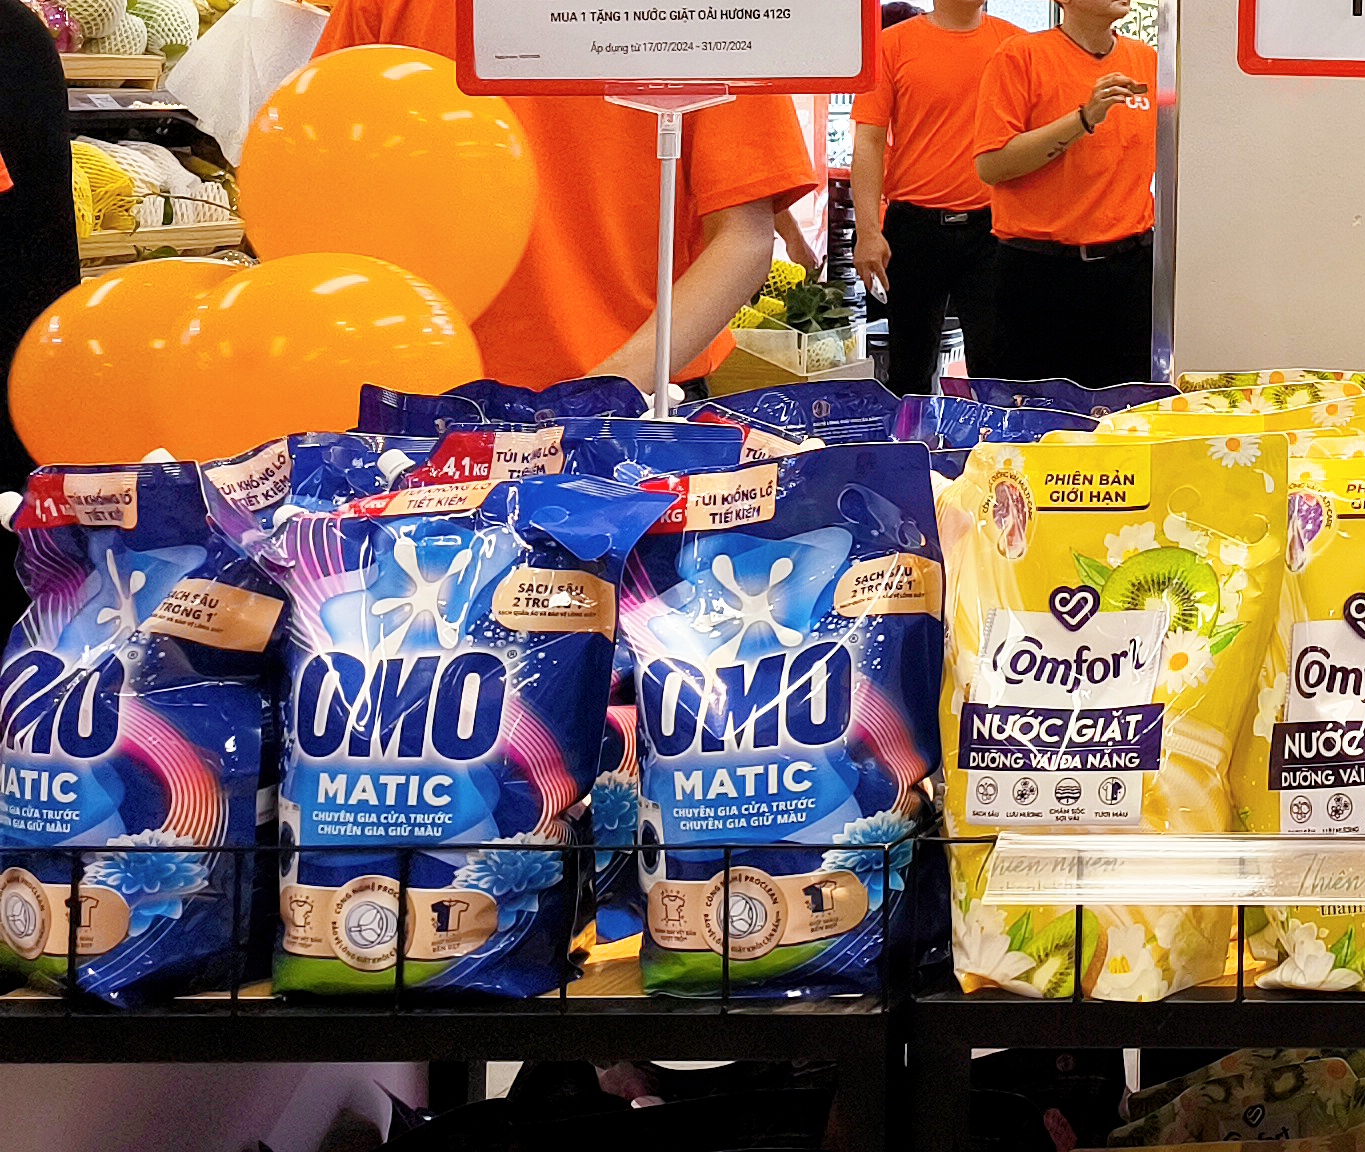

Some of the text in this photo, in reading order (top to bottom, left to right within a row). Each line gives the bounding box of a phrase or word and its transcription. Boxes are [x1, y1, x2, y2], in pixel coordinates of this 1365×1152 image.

[1044, 470, 1135, 486] PHIÊN BẢN
[1049, 485, 1126, 506] GIỚI HẠN
[993, 634, 1145, 694] Comfort
[299, 652, 505, 761] OMO
[640, 641, 853, 758] OMO
[317, 772, 455, 806] MATIC
[672, 761, 814, 802] MATIC
[312, 810, 355, 823] CHUYÊN
[358, 811, 378, 823] GIA
[411, 810, 453, 825] TRƯỚC
